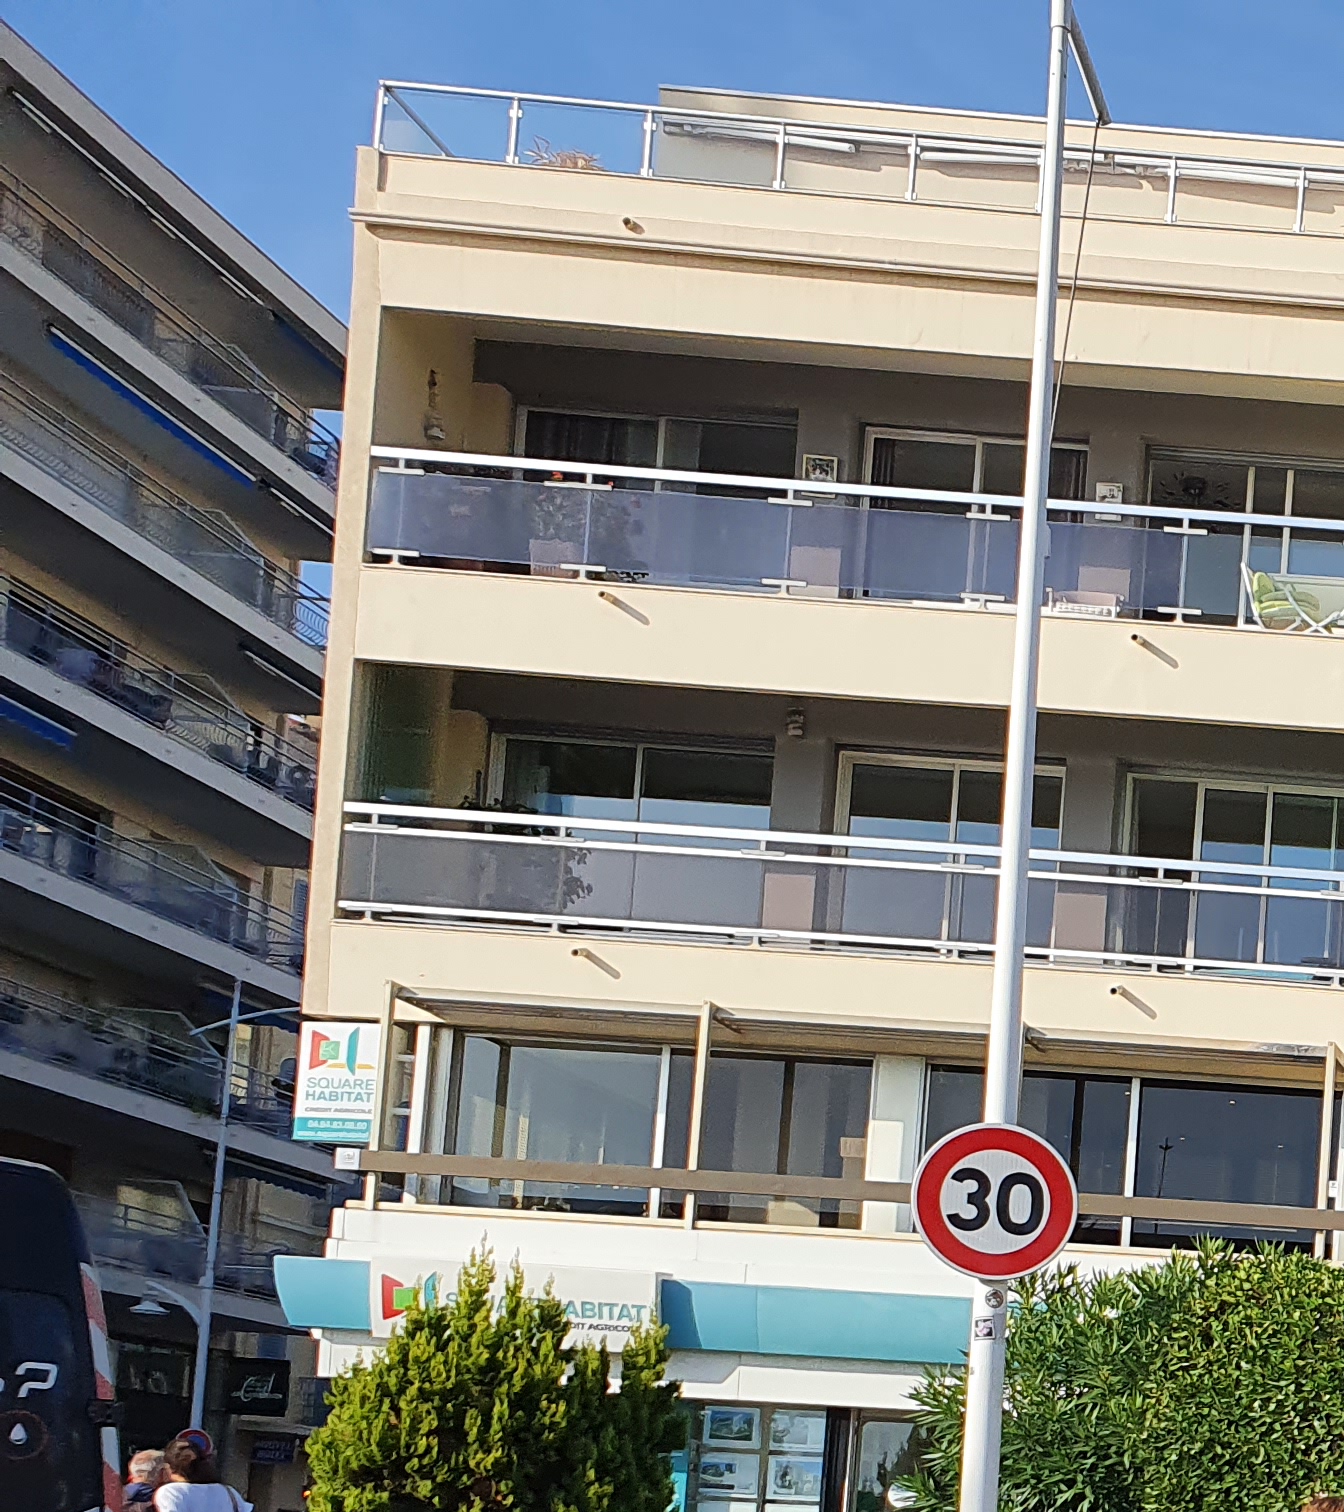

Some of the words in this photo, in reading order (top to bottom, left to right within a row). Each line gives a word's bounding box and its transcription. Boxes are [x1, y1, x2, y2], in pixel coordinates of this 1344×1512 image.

[306, 1077, 376, 1091] SQUARE
[304, 1090, 375, 1103] HABITAT
[946, 1167, 1044, 1236] 30
[562, 1299, 647, 1323] ABITAT
[588, 1323, 632, 1332] AGRICO
